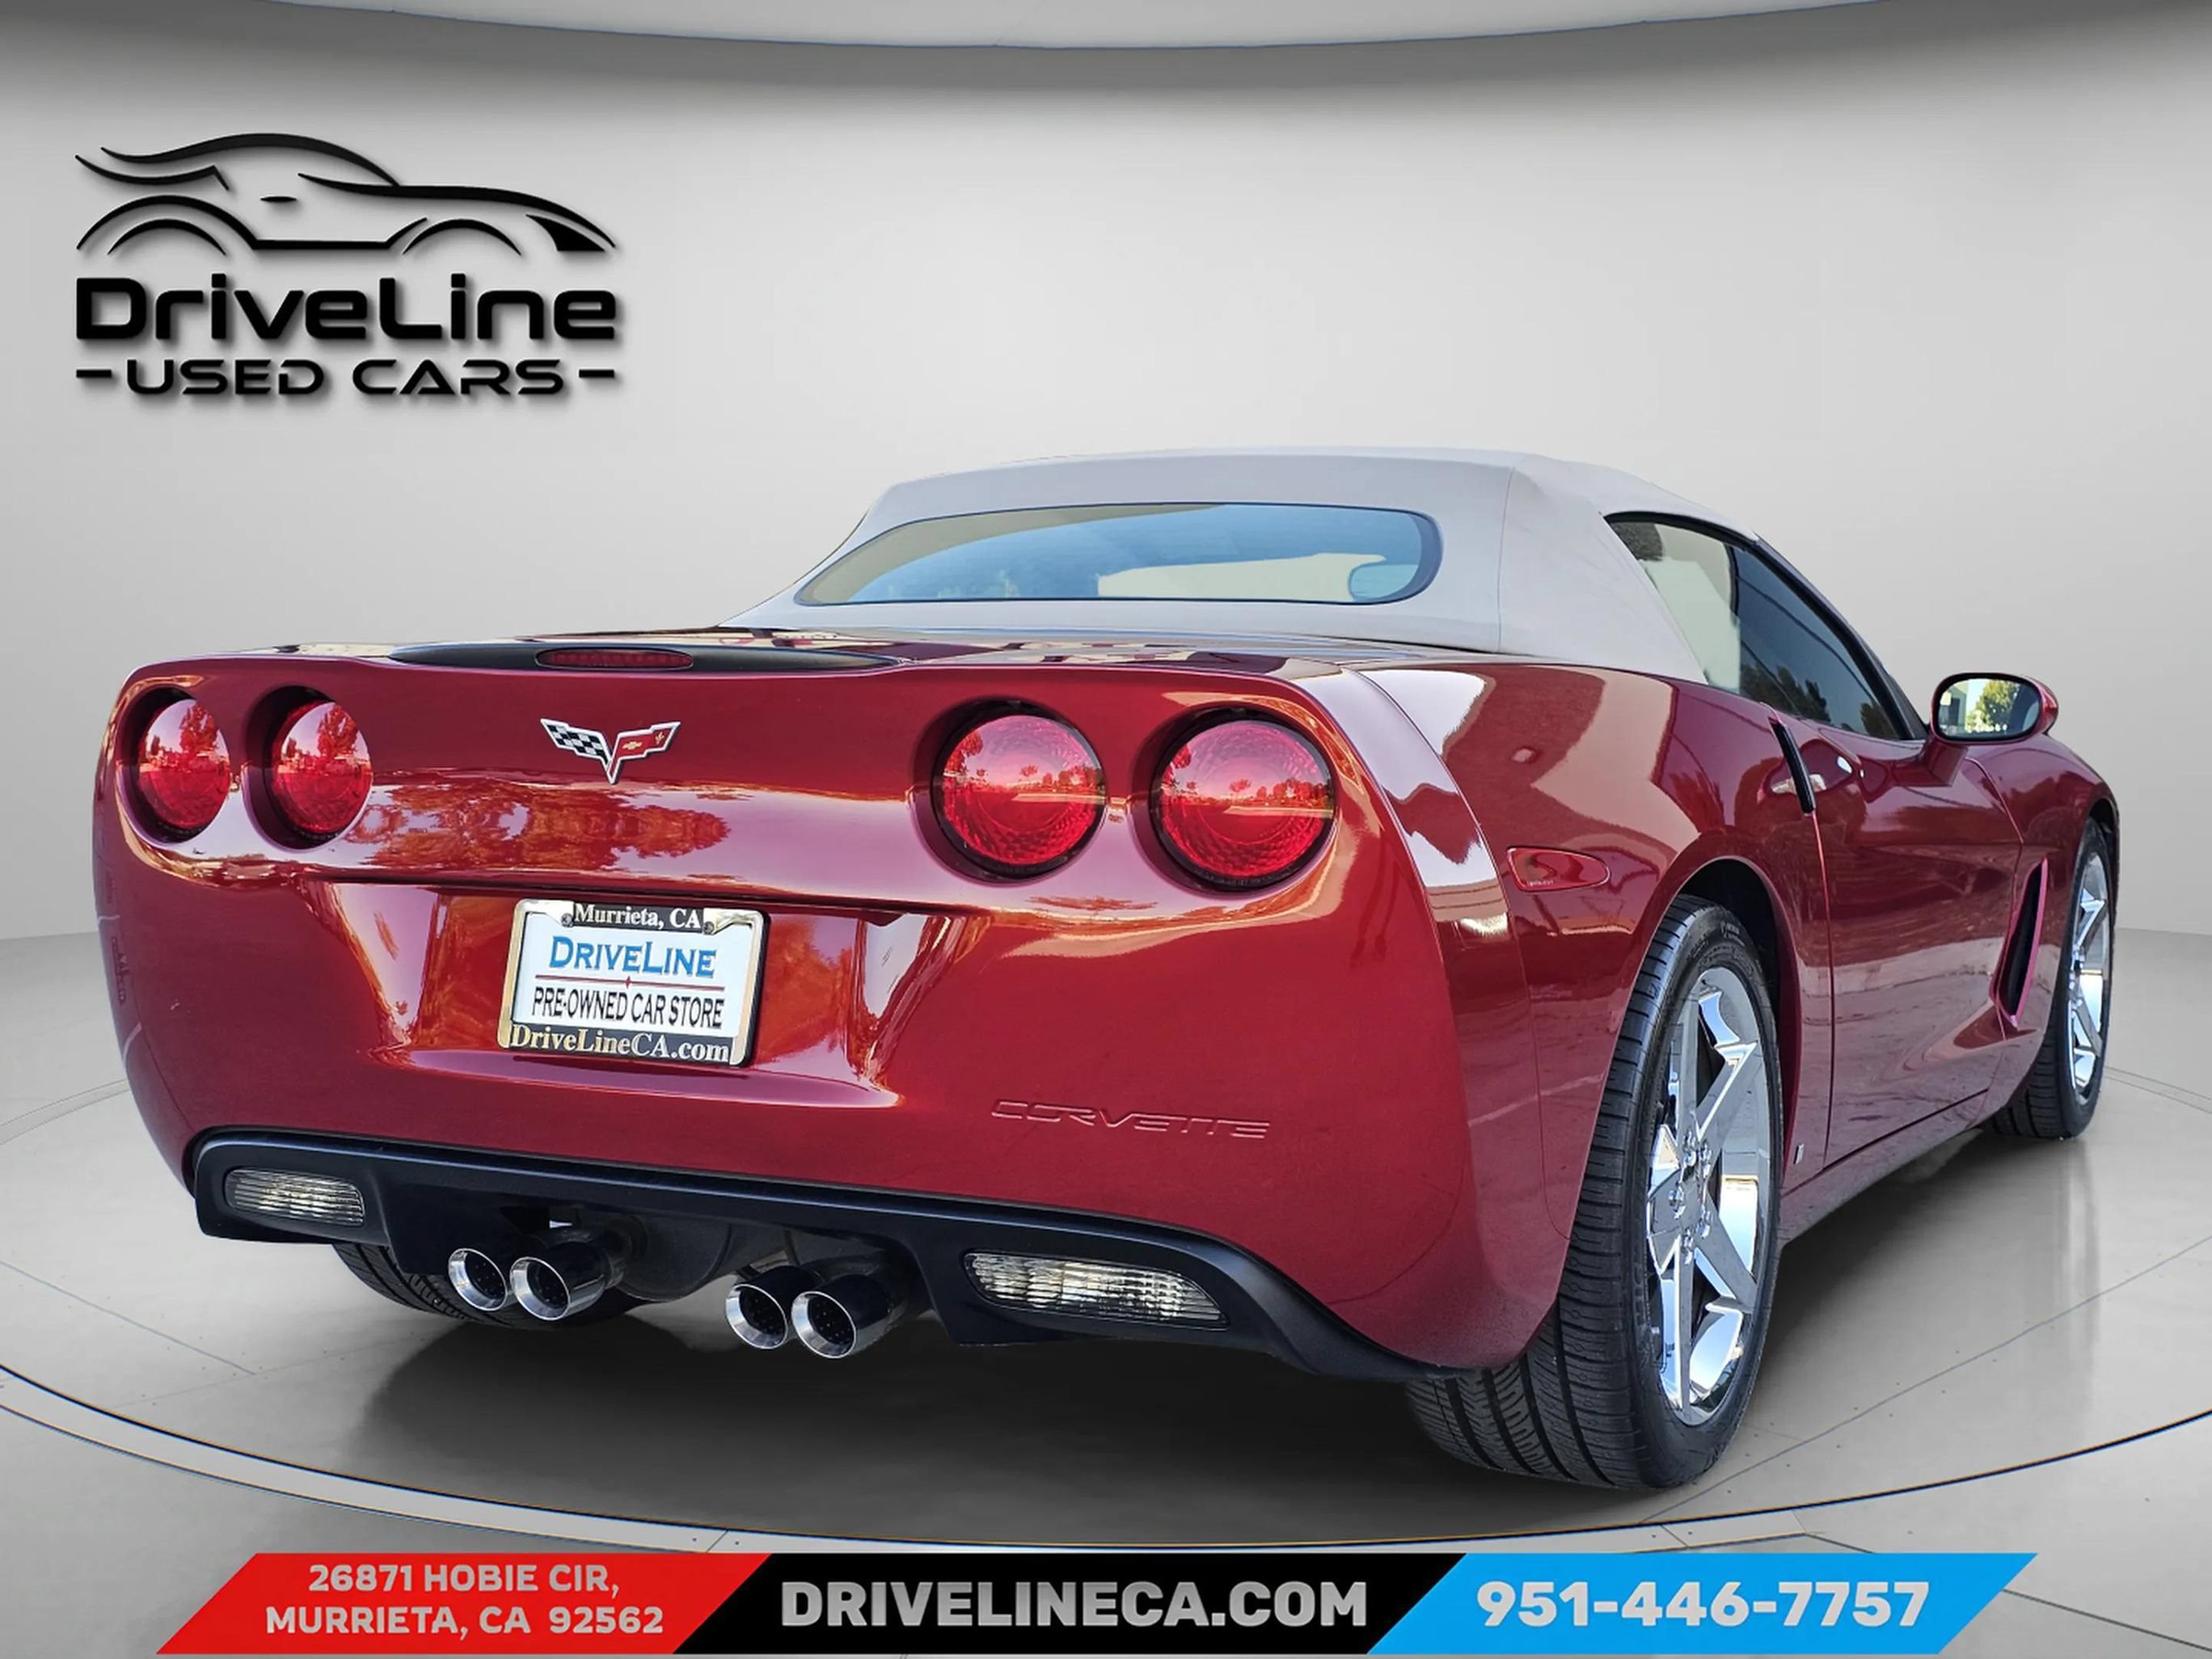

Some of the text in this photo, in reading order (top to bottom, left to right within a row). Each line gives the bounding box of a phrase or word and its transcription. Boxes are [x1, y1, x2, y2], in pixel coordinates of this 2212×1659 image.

[575, 902, 701, 931] Murrieta, CA
[531, 986, 725, 1030] PRE-OWNED CAR STORE
[510, 1024, 730, 1062] DriveLineCA.com
[990, 1100, 1270, 1138] CORVETTE
